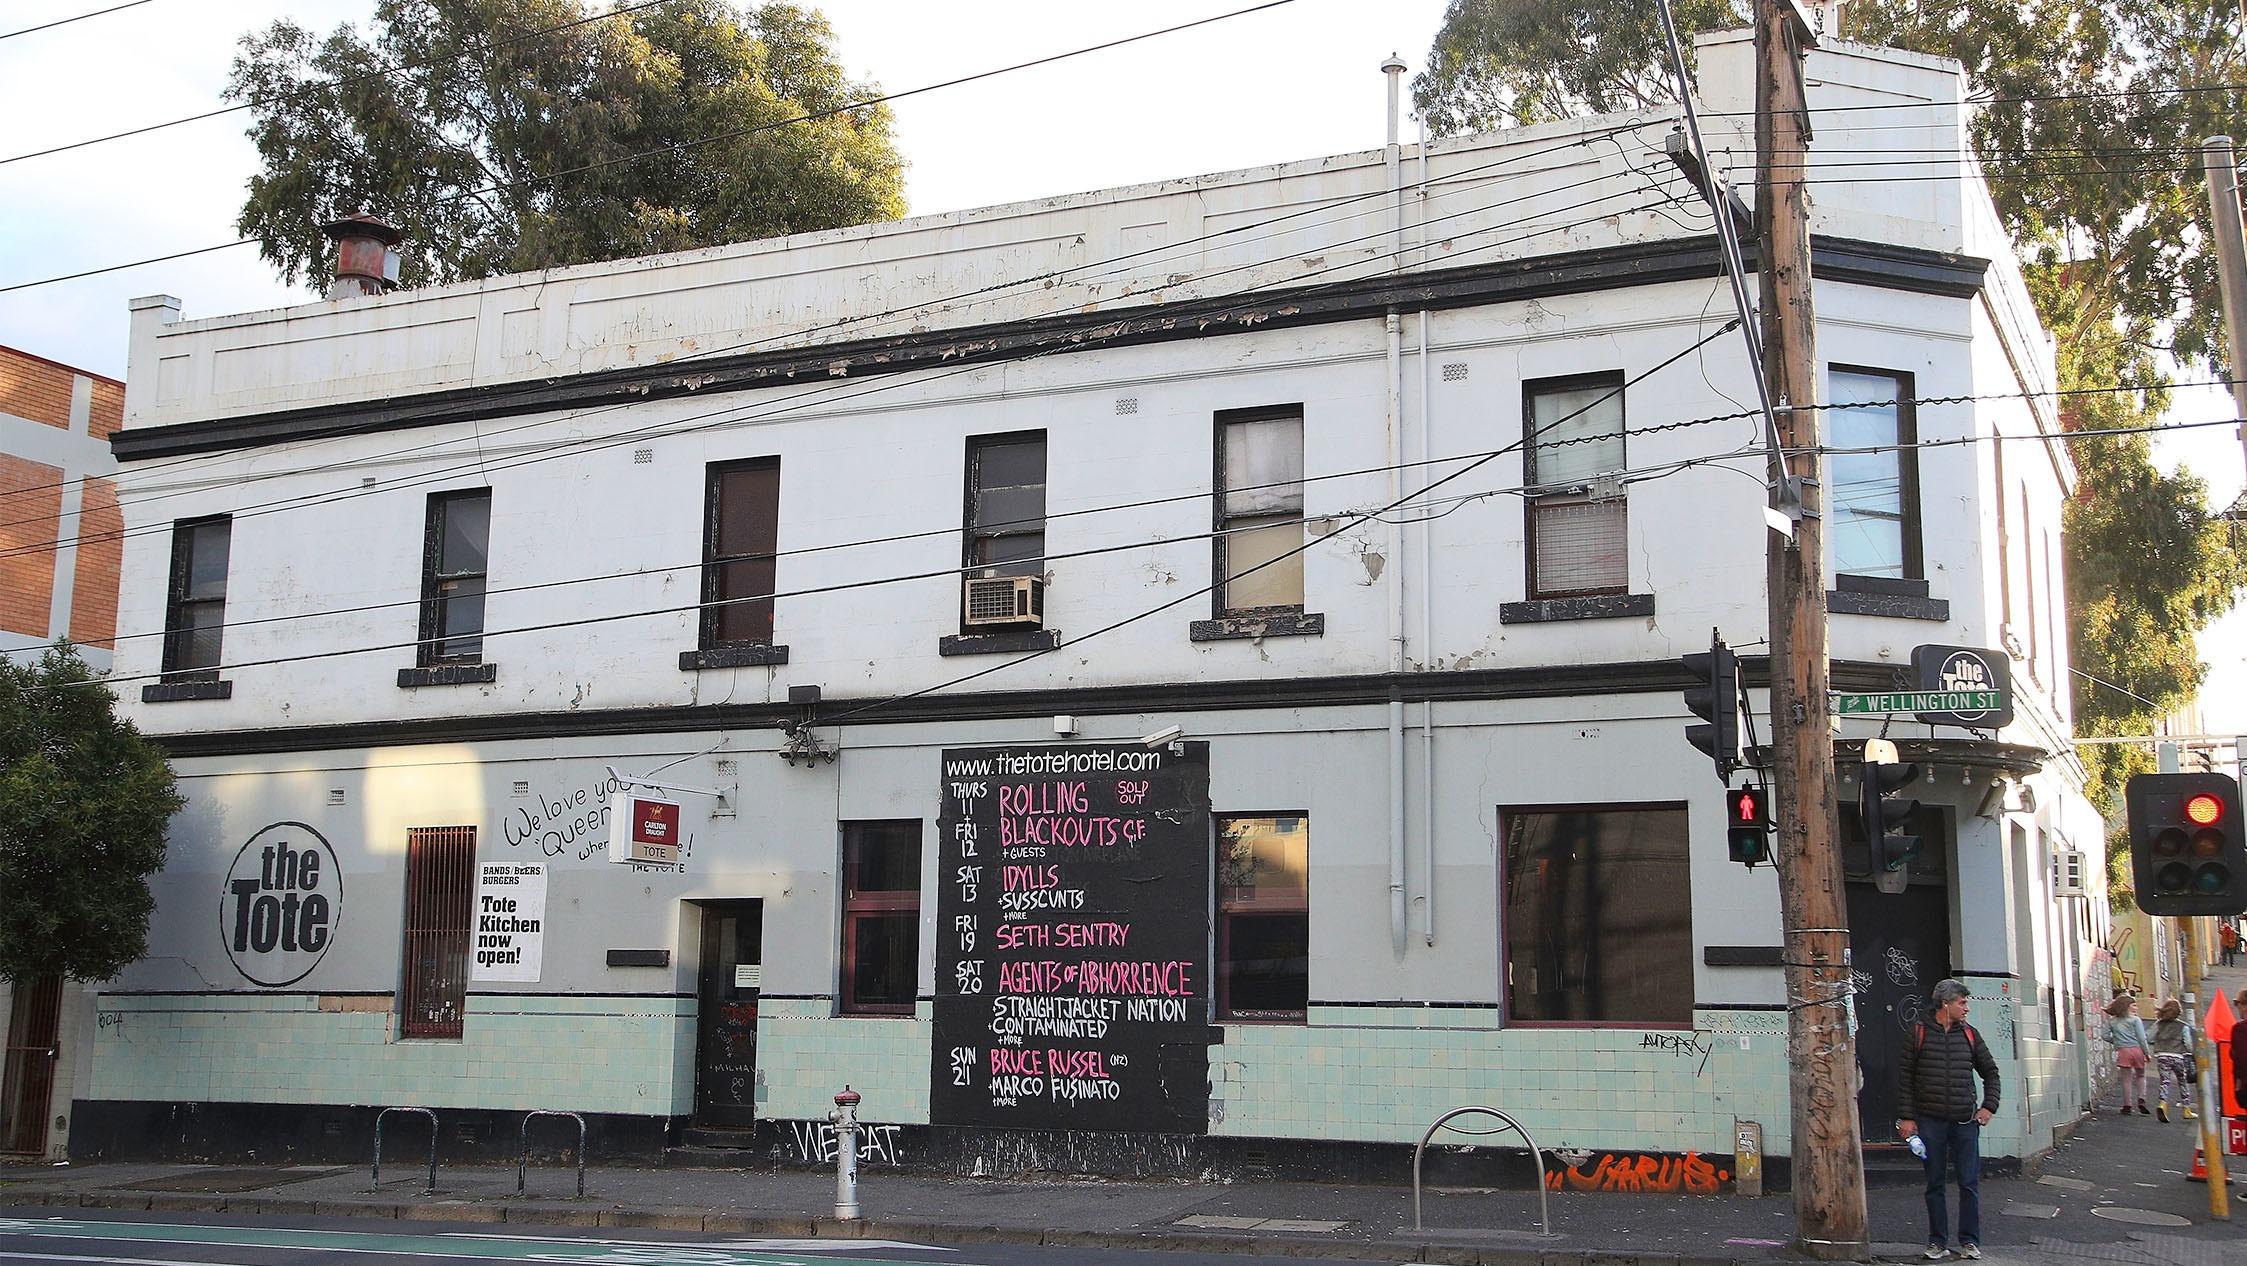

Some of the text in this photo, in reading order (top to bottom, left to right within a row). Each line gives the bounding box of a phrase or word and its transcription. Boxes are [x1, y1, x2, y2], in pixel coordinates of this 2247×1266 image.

[1954, 659, 1983, 682] the
[1866, 693, 1970, 711] WELLINGTON
[1976, 692, 1996, 709] ST
[946, 749, 1161, 777] www.thetotehotel.com
[950, 781, 988, 799] THURS
[1118, 780, 1149, 796] SOLD
[999, 781, 1089, 816] ROLLING
[1119, 793, 1146, 805] OUT
[503, 807, 542, 847] We
[538, 789, 587, 821] love
[955, 822, 978, 841] FRI
[1000, 815, 1121, 847] BLACKOUTS
[643, 846, 667, 859] TOTE
[961, 840, 979, 858] 12
[261, 841, 321, 891] the
[955, 864, 983, 884] SAT
[482, 876, 520, 886] BURGERS
[1002, 864, 1059, 892] IDYLLS
[962, 884, 978, 903] 13
[481, 895, 517, 913] Tote
[230, 878, 330, 954] Tote
[479, 915, 541, 933] Kitchen
[955, 914, 978, 933] FRI
[478, 934, 512, 948] now
[961, 931, 976, 953] 19
[996, 922, 1130, 950] SETH SENTRY
[476, 946, 522, 968] open!
[955, 960, 985, 978] SAT
[999, 960, 1195, 996] AGENTS OF ABHORRENCE
[958, 977, 983, 995] 20
[1127, 998, 1187, 1022] NATION
[950, 1046, 977, 1067] SUN
[990, 1048, 1045, 1076] BRUCE
[1047, 1048, 1110, 1079] RUSSEL
[952, 1066, 971, 1086] 21
[1050, 1077, 1121, 1104] FUSINATO
